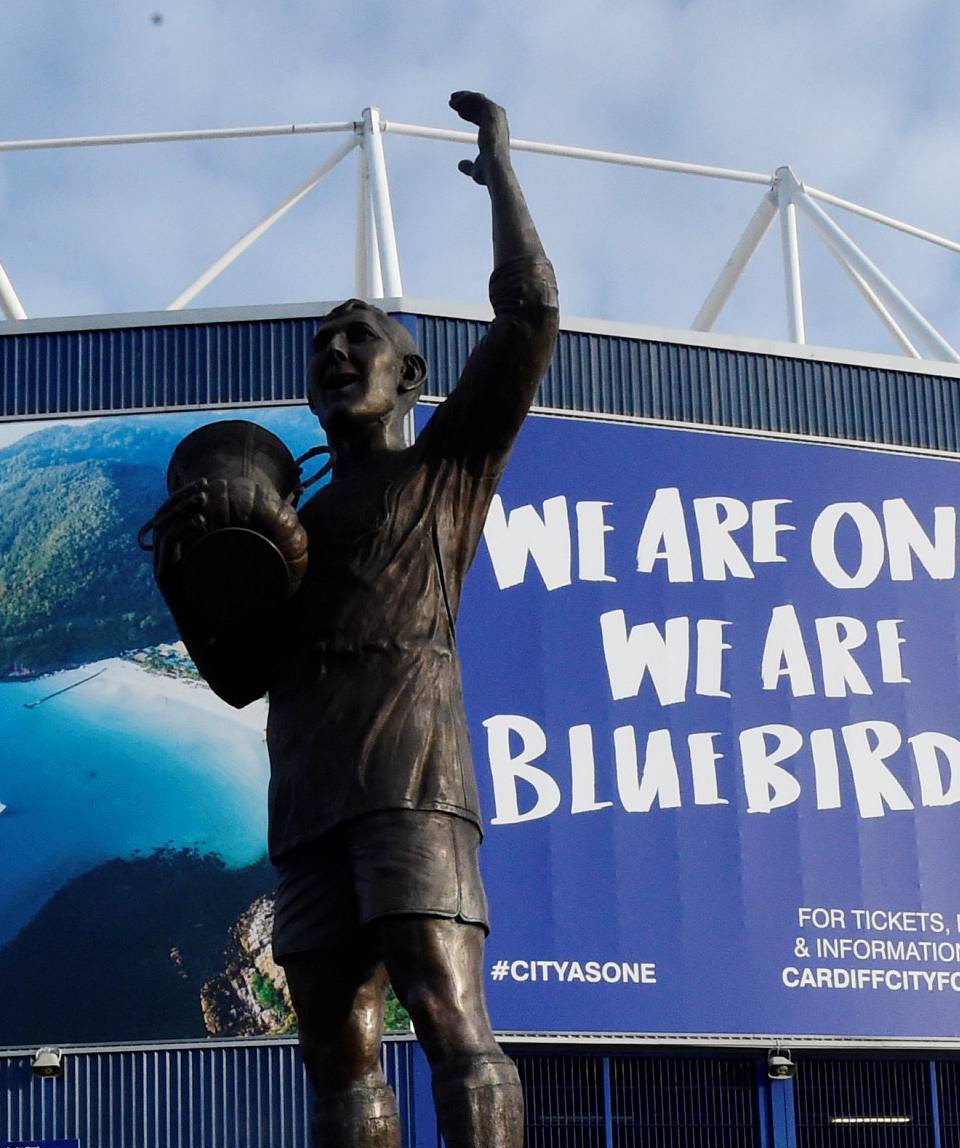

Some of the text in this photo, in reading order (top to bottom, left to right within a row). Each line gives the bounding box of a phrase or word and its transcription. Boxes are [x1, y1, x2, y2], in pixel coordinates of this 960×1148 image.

[483, 494, 617, 591] WE
[636, 487, 796, 581] ARE
[600, 604, 911, 706] WE ARE
[482, 714, 960, 825] BLUEBIRD
[794, 937, 960, 962] & INFORMATIO
[798, 907, 845, 929] FOR
[851, 909, 950, 935] TICKETS,
[490, 960, 657, 983] #CITYASONE
